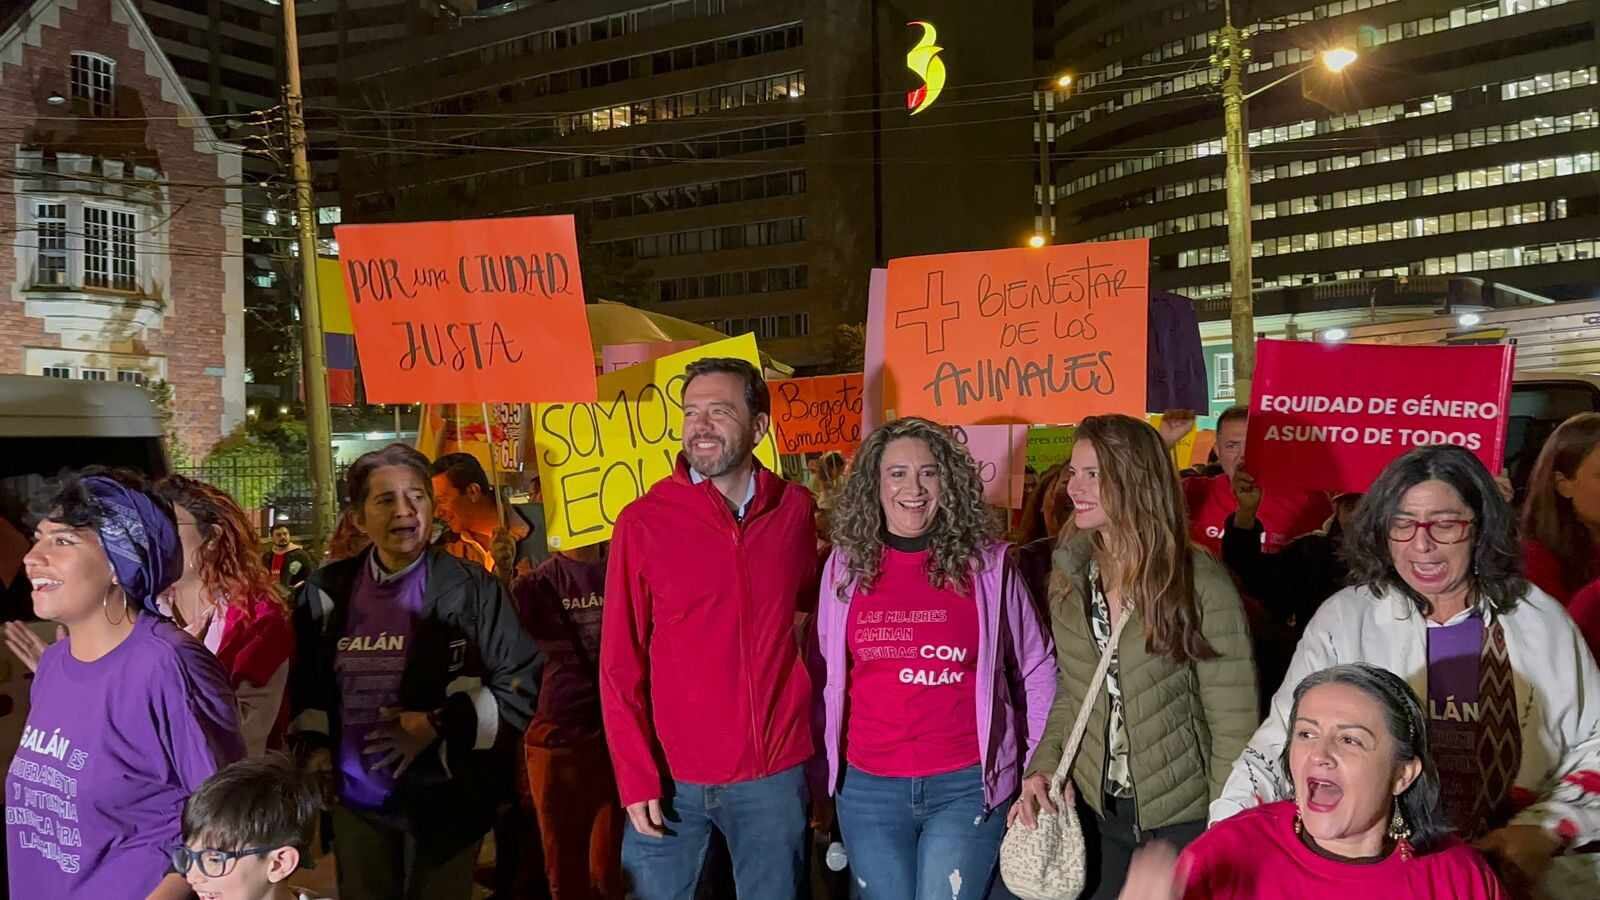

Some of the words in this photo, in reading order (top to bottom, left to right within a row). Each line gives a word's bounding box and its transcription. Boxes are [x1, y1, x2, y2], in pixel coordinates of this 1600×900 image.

[348, 256, 417, 303] POR
[413, 265, 450, 292] una
[458, 252, 573, 300] CIUDAD
[978, 256, 1145, 317] BIENESTAR
[1000, 320, 1040, 349] DE
[1054, 311, 1097, 341] LOS
[392, 320, 523, 371] JUSTA
[923, 351, 1115, 406] ANIMALES
[1260, 395, 1363, 415] EQUIDAD
[1368, 397, 1397, 415] DE
[1402, 394, 1498, 419] GÉNERO
[543, 374, 687, 467] SOMOS
[1264, 425, 1358, 443] ASUNTO
[1363, 428, 1392, 444] DE
[1398, 429, 1481, 450] TODOS
[857, 610, 883, 624] LAS
[885, 609, 947, 623] MUJERES
[336, 632, 405, 651] GALÁN
[855, 627, 913, 643] CAMINAN
[920, 645, 967, 662] CON
[899, 667, 964, 686] GALÁN
[1430, 695, 1480, 722] LÁN
